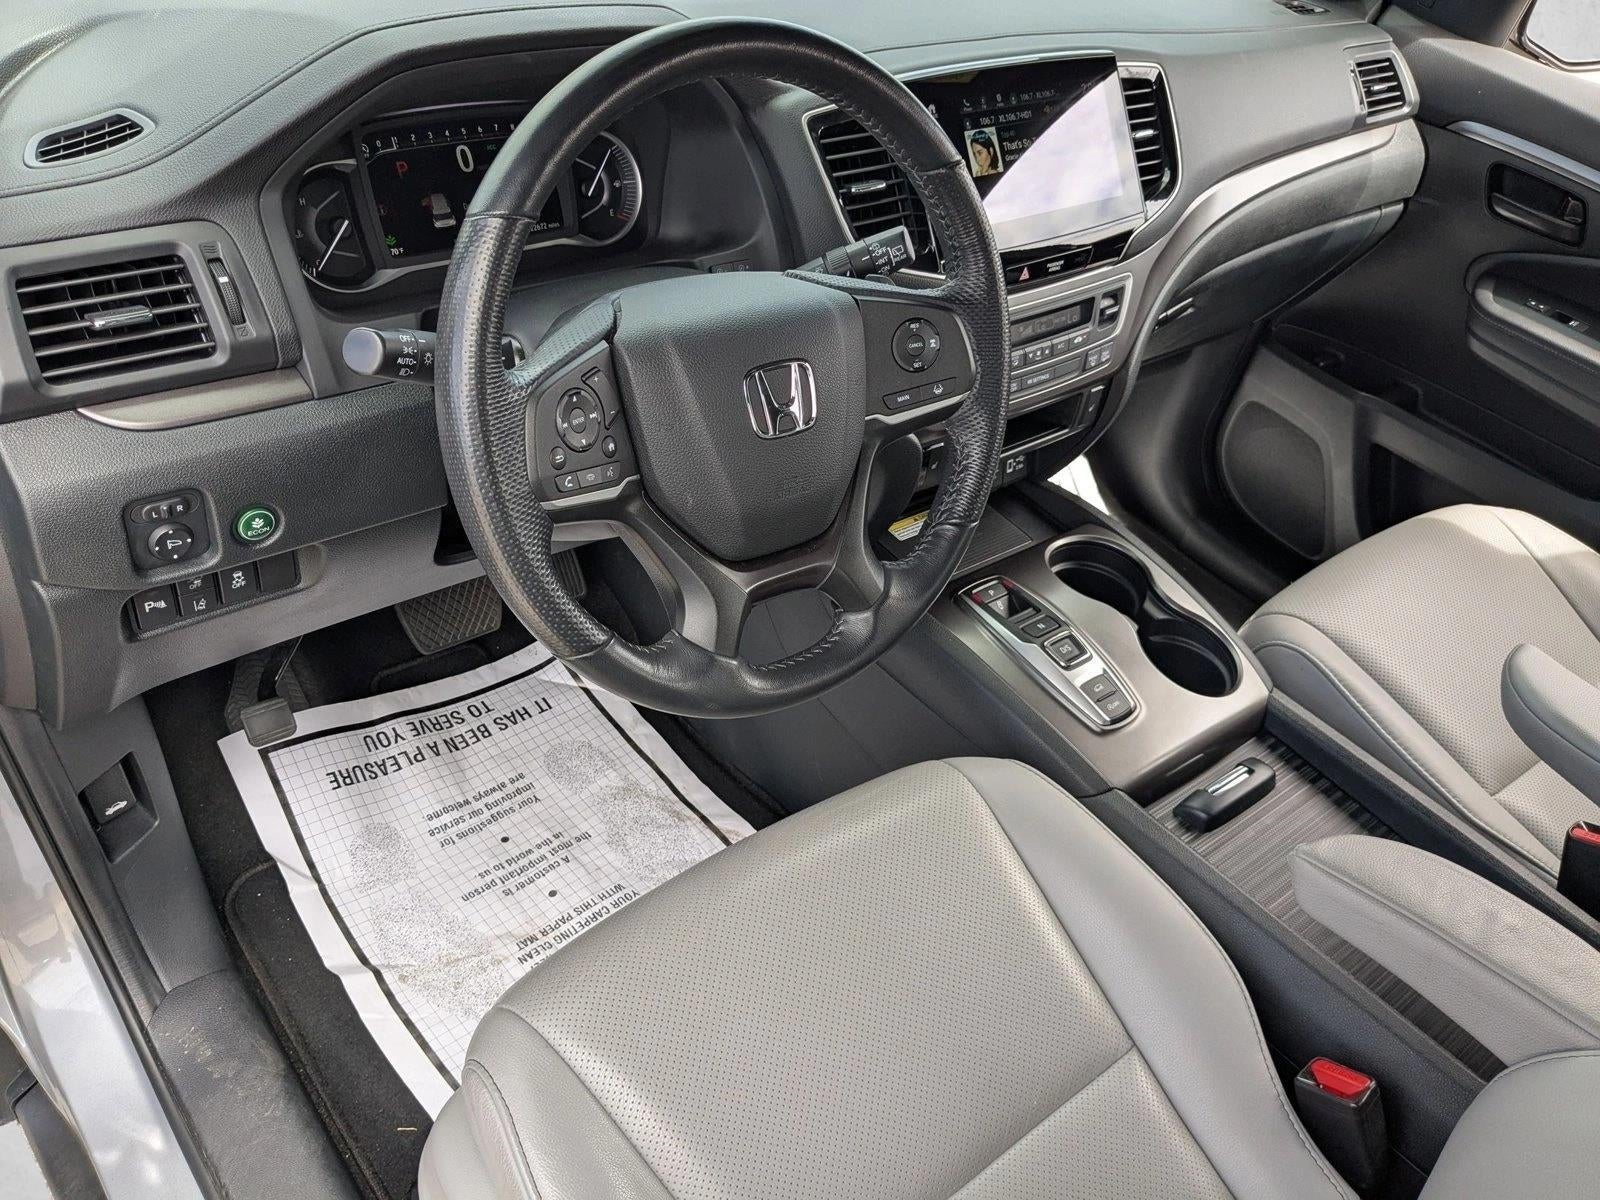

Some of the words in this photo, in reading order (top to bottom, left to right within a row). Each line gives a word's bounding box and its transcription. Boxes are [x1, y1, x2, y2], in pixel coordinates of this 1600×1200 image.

[1003, 140, 1023, 151] That's
[455, 144, 475, 173] 0
[399, 334, 412, 343] OFF
[397, 357, 414, 366] AUTO
[176, 504, 184, 512] R
[247, 526, 271, 536] ECON
[189, 581, 202, 590] OFF
[231, 580, 247, 589] OFF
[467, 700, 496, 718] TO
[535, 697, 553, 715] IT
[405, 710, 466, 738] SERVE
[494, 706, 532, 732] HAS
[362, 726, 407, 753] YOU
[444, 723, 493, 753] BEEN
[427, 741, 441, 757] A
[325, 748, 427, 791] PLEASURE
[509, 772, 526, 785] are
[472, 781, 508, 802] always
[486, 782, 537, 812] improving
[422, 799, 472, 822] welcome.
[517, 793, 541, 811] Your
[455, 806, 516, 840] suggestions
[468, 807, 485, 821] our
[427, 816, 467, 837] service
[439, 837, 456, 849] for
[534, 837, 553, 850] the
[551, 831, 565, 841] in
[575, 831, 592, 844] the
[504, 848, 535, 867] world
[549, 840, 574, 859] most
[492, 862, 506, 873] to
[561, 855, 571, 864] A
[473, 868, 493, 880] us.
[499, 854, 546, 886] important
[515, 859, 561, 892] customer
[461, 879, 499, 902] person
[502, 888, 515, 898] is
[598, 883, 626, 902] WITH
[612, 889, 641, 910] YOUR
[573, 898, 599, 916] THIS
[539, 912, 574, 937] PAPER
[553, 905, 611, 945] CARPETING
[515, 934, 540, 952] MAT
[517, 940, 554, 966] CLEAN
